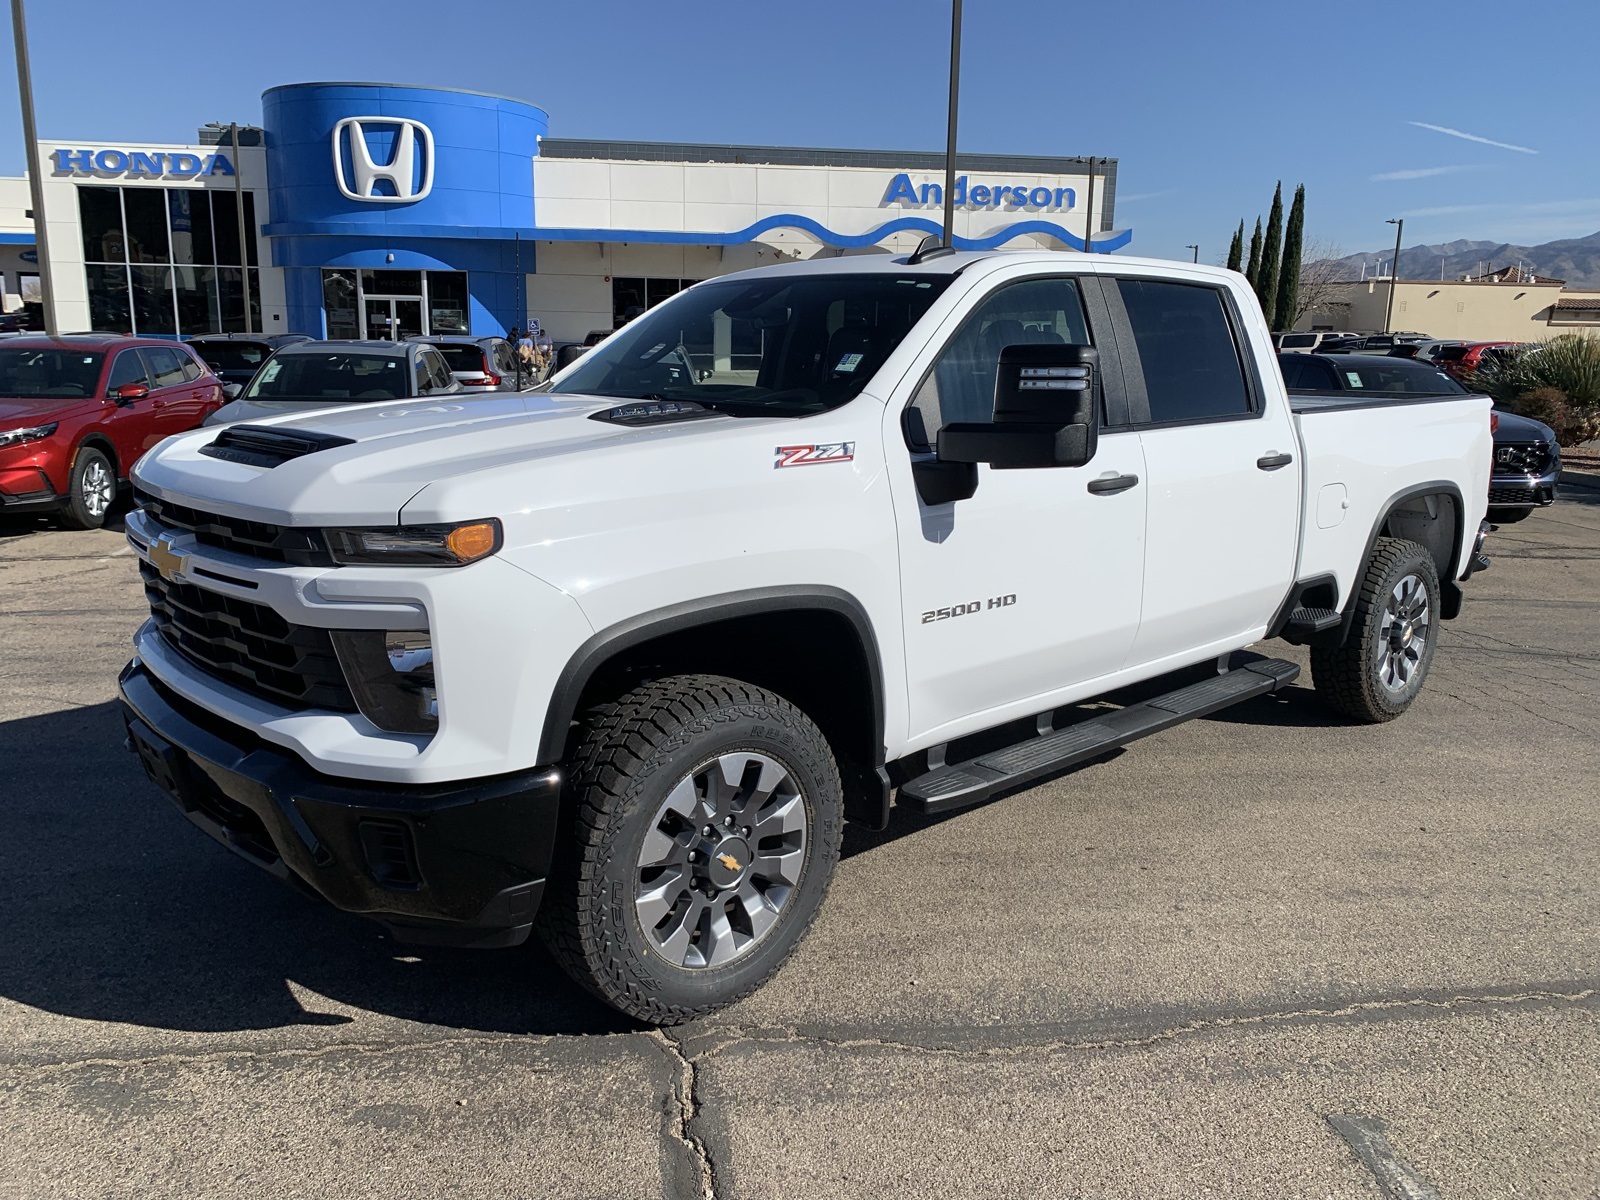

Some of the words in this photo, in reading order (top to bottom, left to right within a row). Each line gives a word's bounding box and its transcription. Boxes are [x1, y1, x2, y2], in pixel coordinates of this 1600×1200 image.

[54, 149, 236, 176] HONDA
[886, 173, 1076, 208] Anderson
[774, 441, 855, 470] Z71
[921, 600, 981, 624] 2500
[987, 593, 1017, 610] HD
[611, 881, 662, 992] FALKEN
